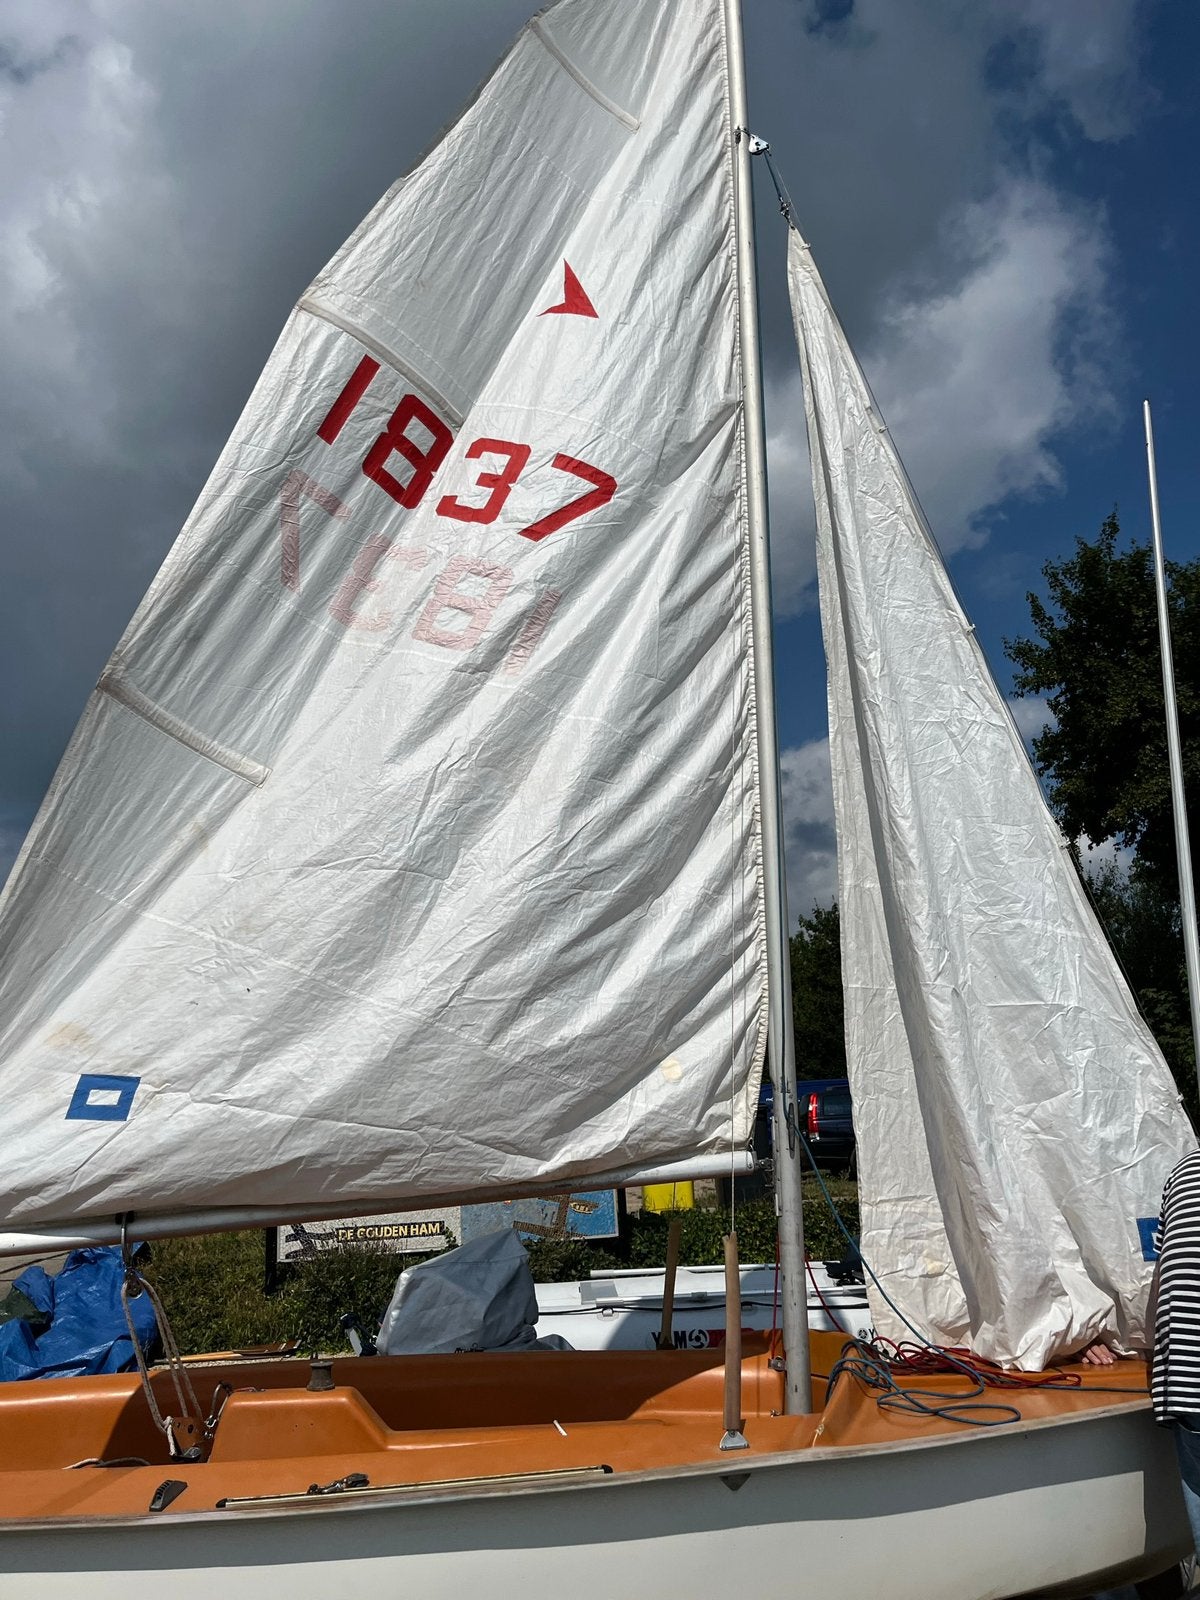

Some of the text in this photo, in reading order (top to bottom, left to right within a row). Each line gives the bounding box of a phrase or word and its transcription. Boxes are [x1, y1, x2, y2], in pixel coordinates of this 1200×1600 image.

[316, 354, 618, 542] 1837
[410, 1222, 440, 1236] HAM
[651, 1330, 688, 1349] YM
